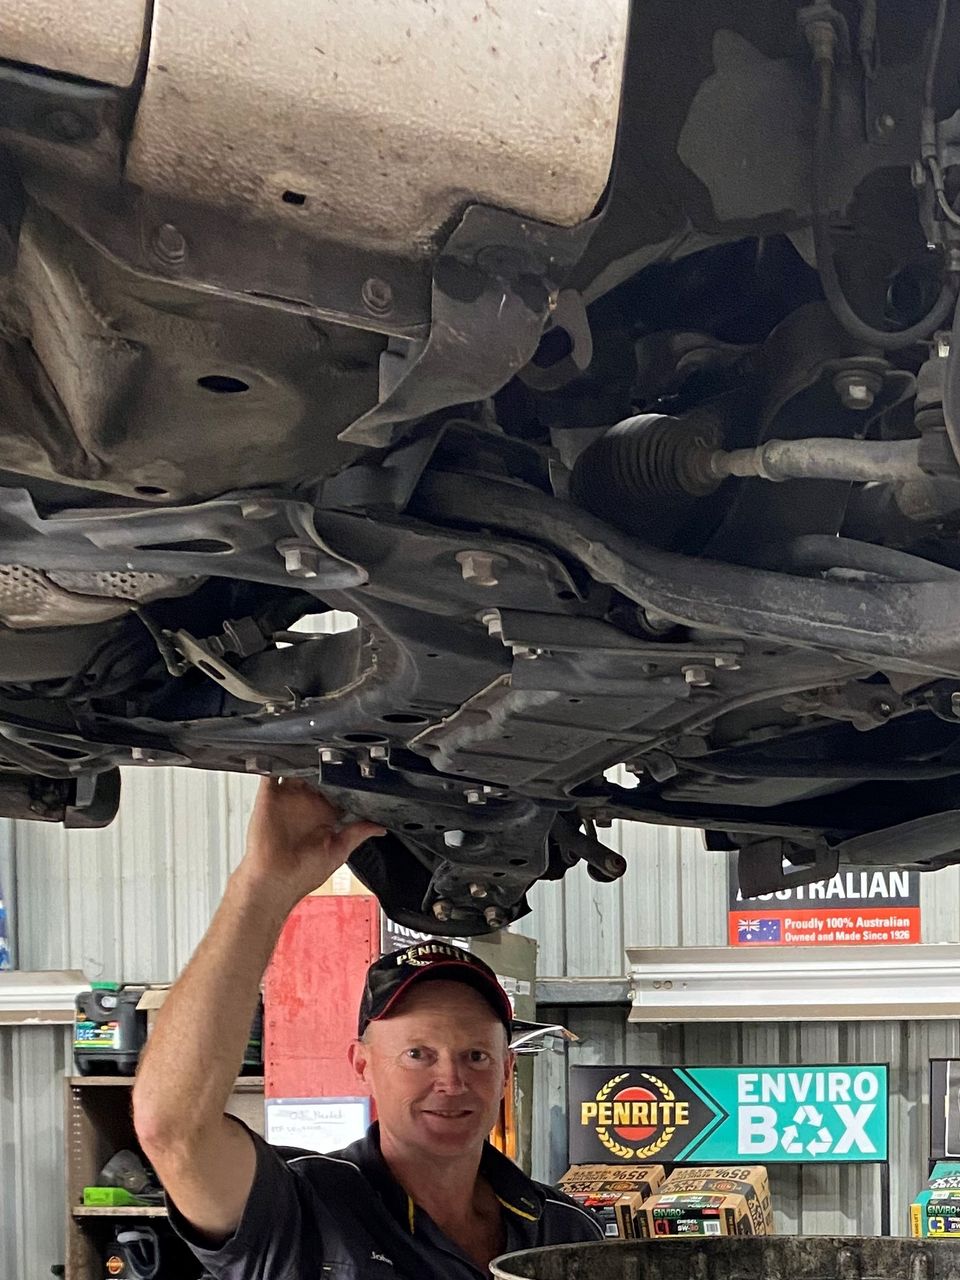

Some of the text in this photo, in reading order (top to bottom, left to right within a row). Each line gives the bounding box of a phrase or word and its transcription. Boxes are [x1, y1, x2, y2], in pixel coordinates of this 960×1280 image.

[784, 917, 910, 931] Proudly 100% Australian
[784, 932, 910, 942] Owned and Made Since 1926
[737, 1071, 879, 1103] ENVIRO
[581, 1101, 690, 1126] PENRITE
[613, 1170, 648, 1180] 85%
[715, 1168, 751, 1181] 85%
[653, 1208, 686, 1217] ENVIRO+
[927, 1205, 960, 1215] ENVIRO+
[927, 1216, 945, 1233] C3
